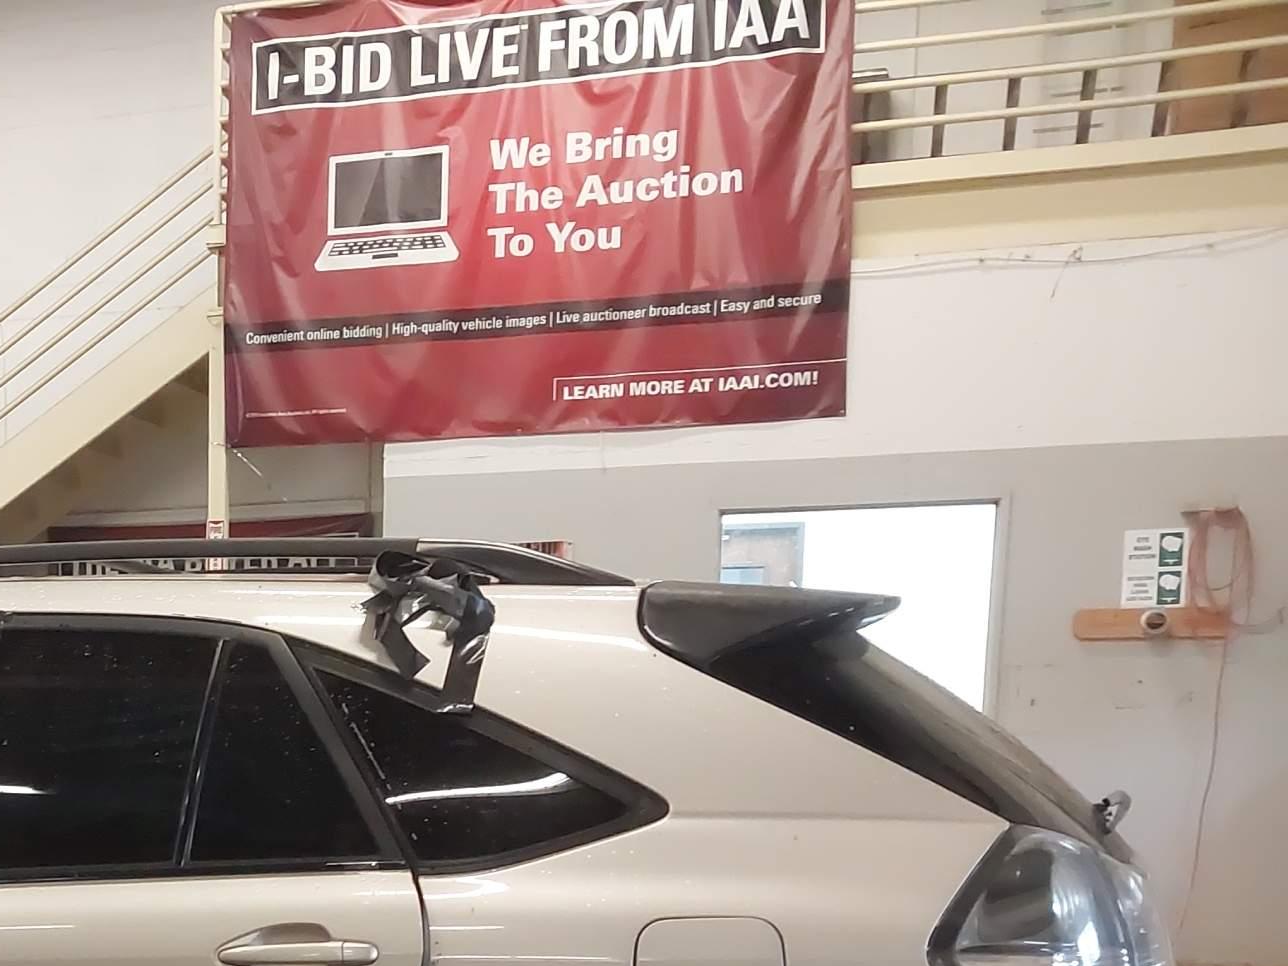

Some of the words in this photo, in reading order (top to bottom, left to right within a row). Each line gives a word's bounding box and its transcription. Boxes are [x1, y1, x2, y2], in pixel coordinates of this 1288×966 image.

[267, 42, 392, 100] I-BID
[410, 24, 520, 87] LIVE
[538, 3, 695, 73] FROM
[713, 0, 810, 51] IAA
[489, 136, 552, 170] We
[565, 127, 679, 164] Bring
[488, 181, 564, 214] The
[575, 165, 743, 208] Auction
[487, 226, 535, 258] To
[545, 221, 623, 253] You
[245, 330, 305, 345] Convenient
[306, 326, 341, 340] online
[343, 324, 383, 339] bidding
[391, 318, 460, 335] High-quality
[461, 316, 504, 330] vehicle
[505, 313, 547, 328] images
[556, 312, 580, 324] Live
[582, 308, 647, 322] auctioneer
[648, 302, 712, 318] broadcast
[720, 299, 751, 314] Easy
[753, 297, 775, 310] and
[777, 293, 822, 307] secure
[563, 383, 624, 400] LEARN
[629, 378, 685, 397] MORE
[688, 378, 714, 394] AT
[718, 371, 818, 392] IAAI.COM!
